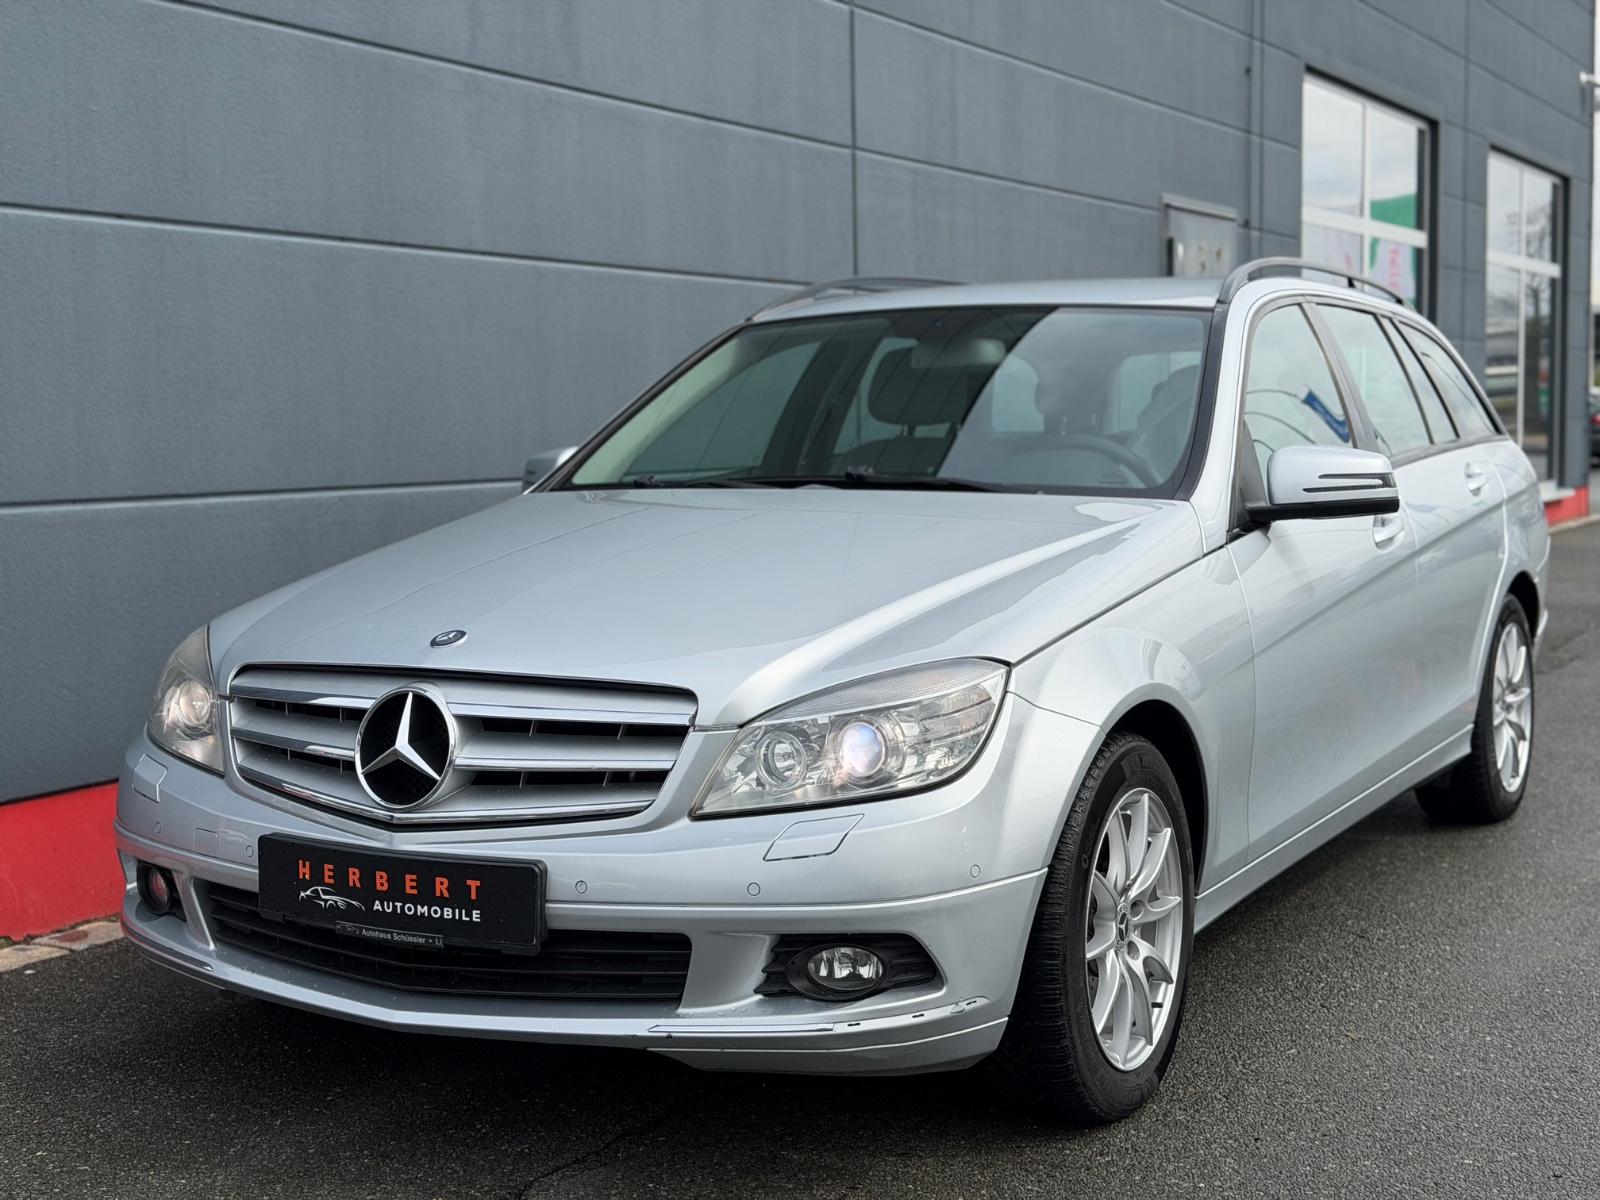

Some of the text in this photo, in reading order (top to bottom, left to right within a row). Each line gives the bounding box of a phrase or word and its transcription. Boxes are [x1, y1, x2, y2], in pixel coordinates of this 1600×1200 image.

[298, 859, 481, 900] HERBERT
[373, 899, 481, 922] AUTOMOBILE
[361, 928, 391, 940] Autohaus
[392, 932, 426, 944] Schüssler
